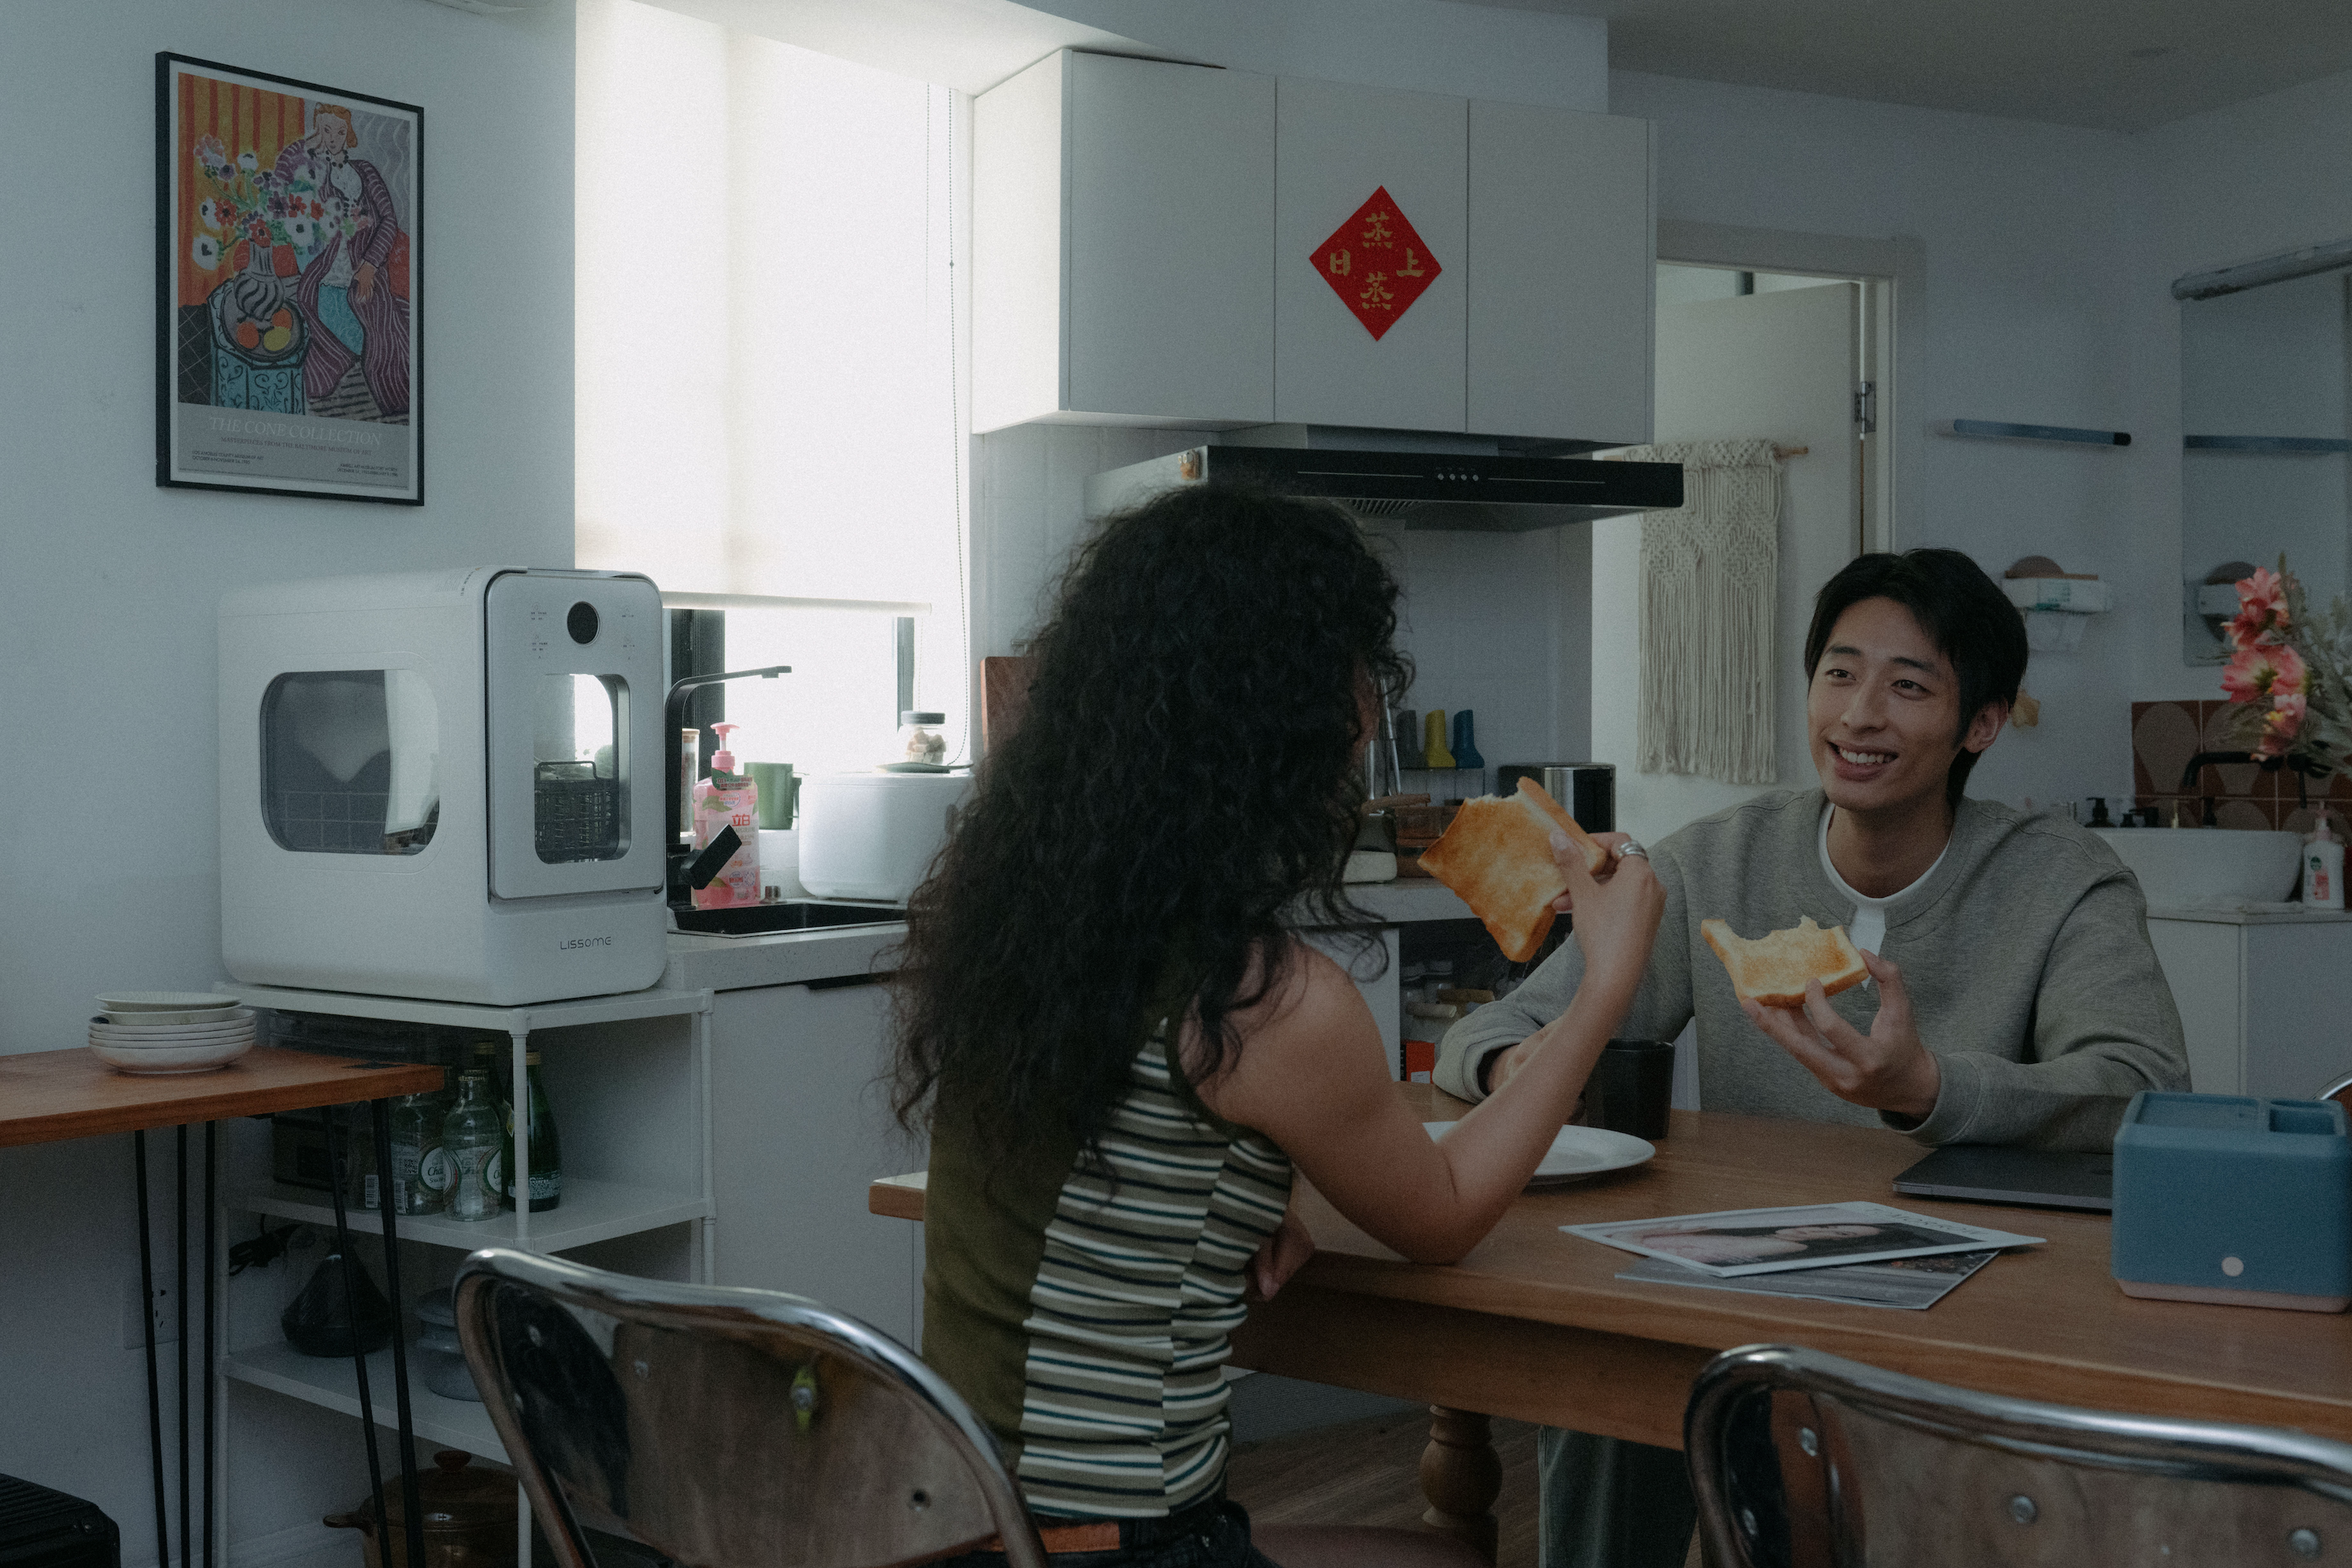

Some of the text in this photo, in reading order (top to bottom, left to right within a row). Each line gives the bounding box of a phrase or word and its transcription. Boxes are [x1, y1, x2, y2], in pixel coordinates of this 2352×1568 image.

[1363, 211, 1394, 249] 蒸
[1330, 248, 1351, 276] 日
[1396, 247, 1425, 278] 上
[1359, 271, 1394, 310] 蒸
[209, 416, 383, 445] THE CONE COLLECTION
[220, 436, 263, 445] MASTERPIECES
[295, 443, 327, 452] BALTIMORE
[731, 813, 750, 826] 立白
[560, 936, 612, 950] LISSOME
